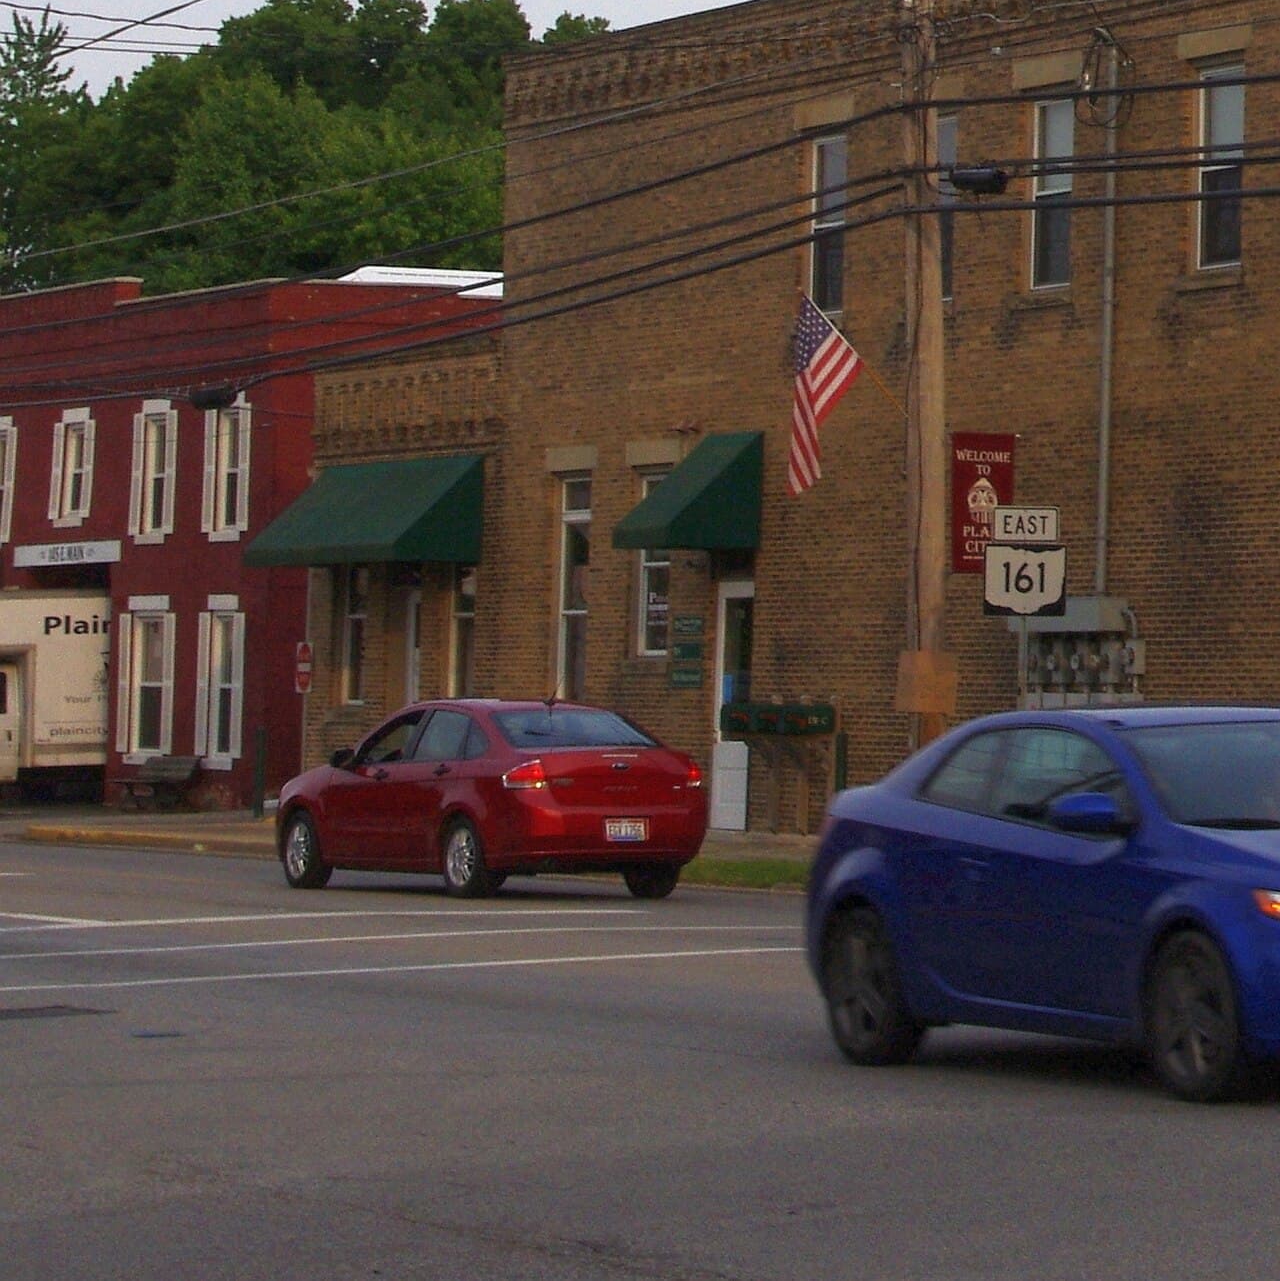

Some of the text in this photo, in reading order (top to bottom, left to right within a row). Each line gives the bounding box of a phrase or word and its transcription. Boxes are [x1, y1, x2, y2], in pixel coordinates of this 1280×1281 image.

[956, 449, 1012, 464] WELCOME
[975, 464, 991, 475] TO
[963, 525, 991, 537] PLA
[1003, 515, 1049, 535] EAST
[965, 540, 990, 553] CIT
[1003, 561, 1046, 593] 161
[64, 695, 92, 703] Your
